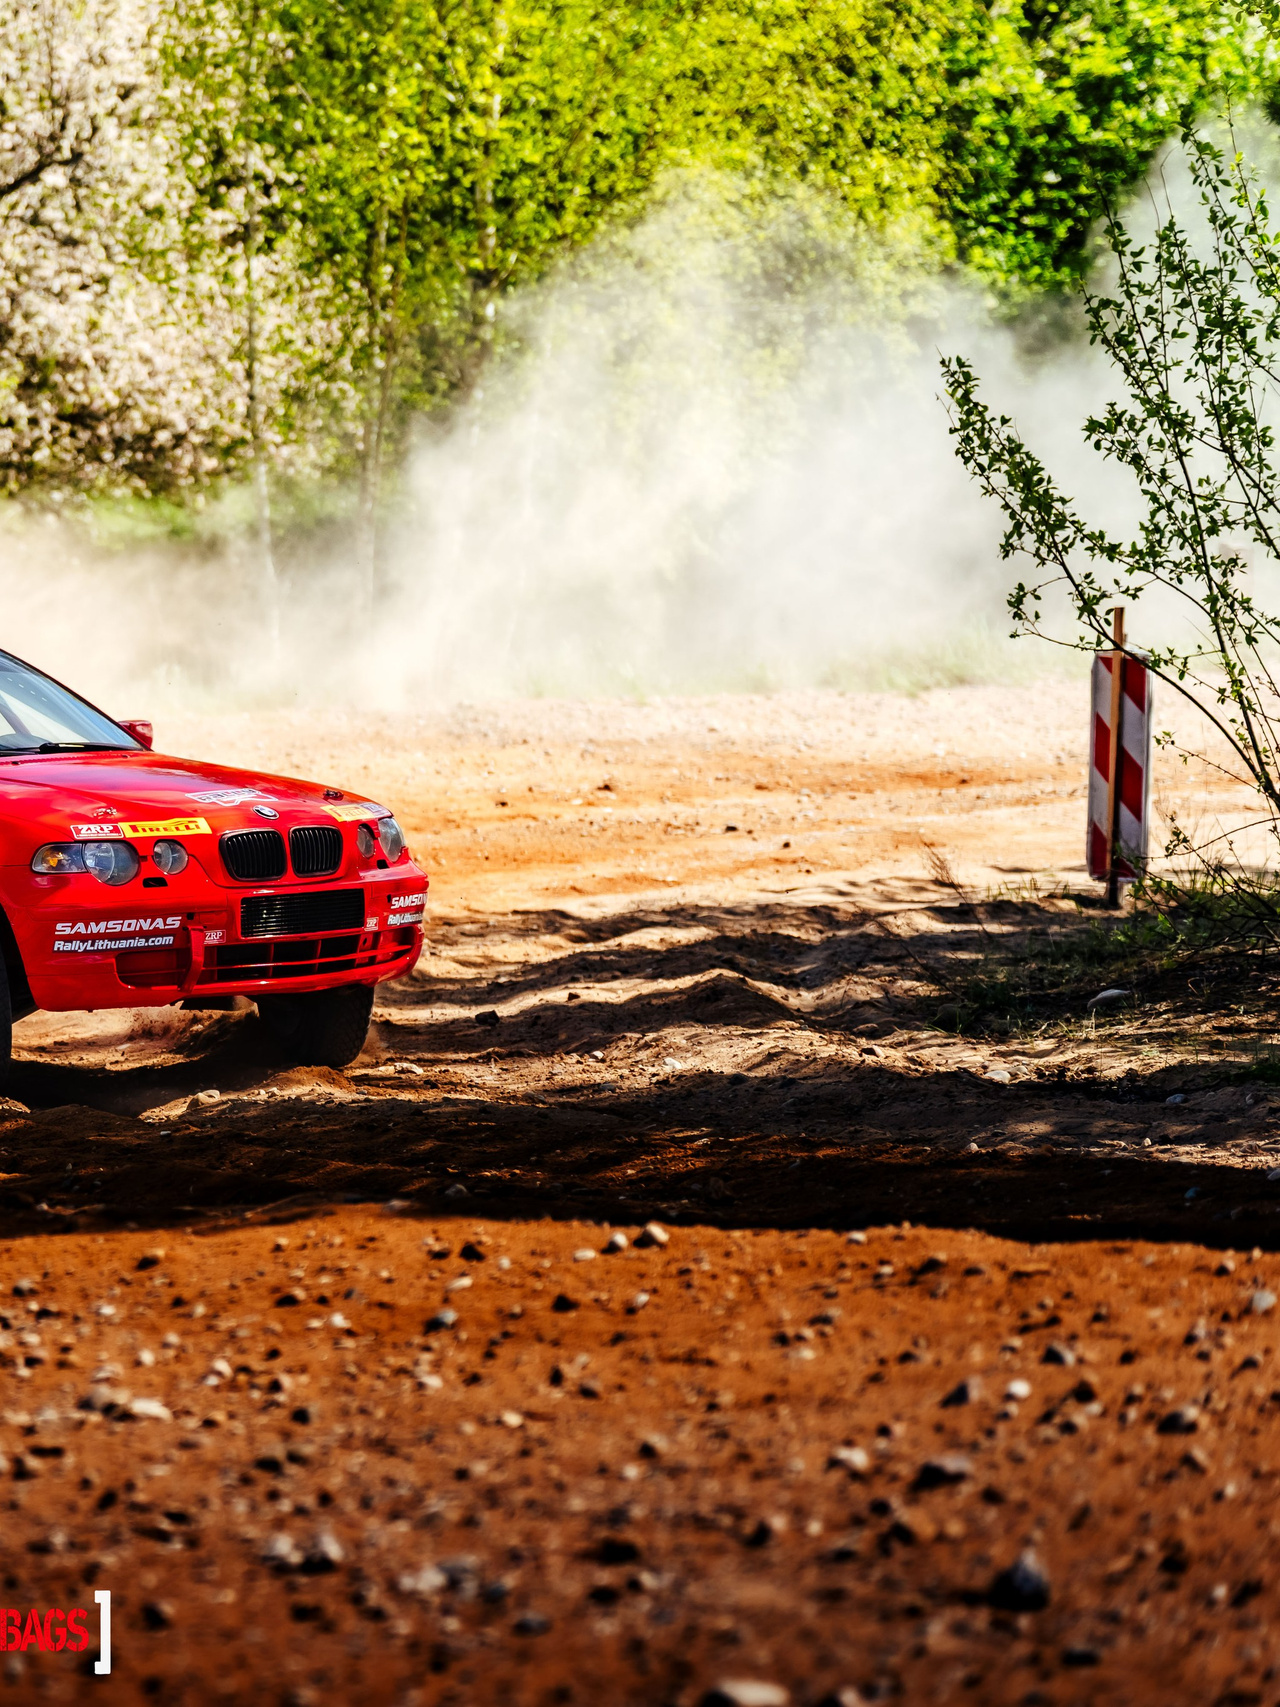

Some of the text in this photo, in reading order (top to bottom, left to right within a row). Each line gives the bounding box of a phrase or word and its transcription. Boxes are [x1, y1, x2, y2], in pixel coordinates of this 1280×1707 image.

[78, 825, 114, 834] ZRP
[128, 820, 200, 833] PIRELLI
[55, 916, 182, 935] SAMSONAS
[205, 931, 223, 941] ZRP
[53, 936, 174, 952] RallyLithuania.com
